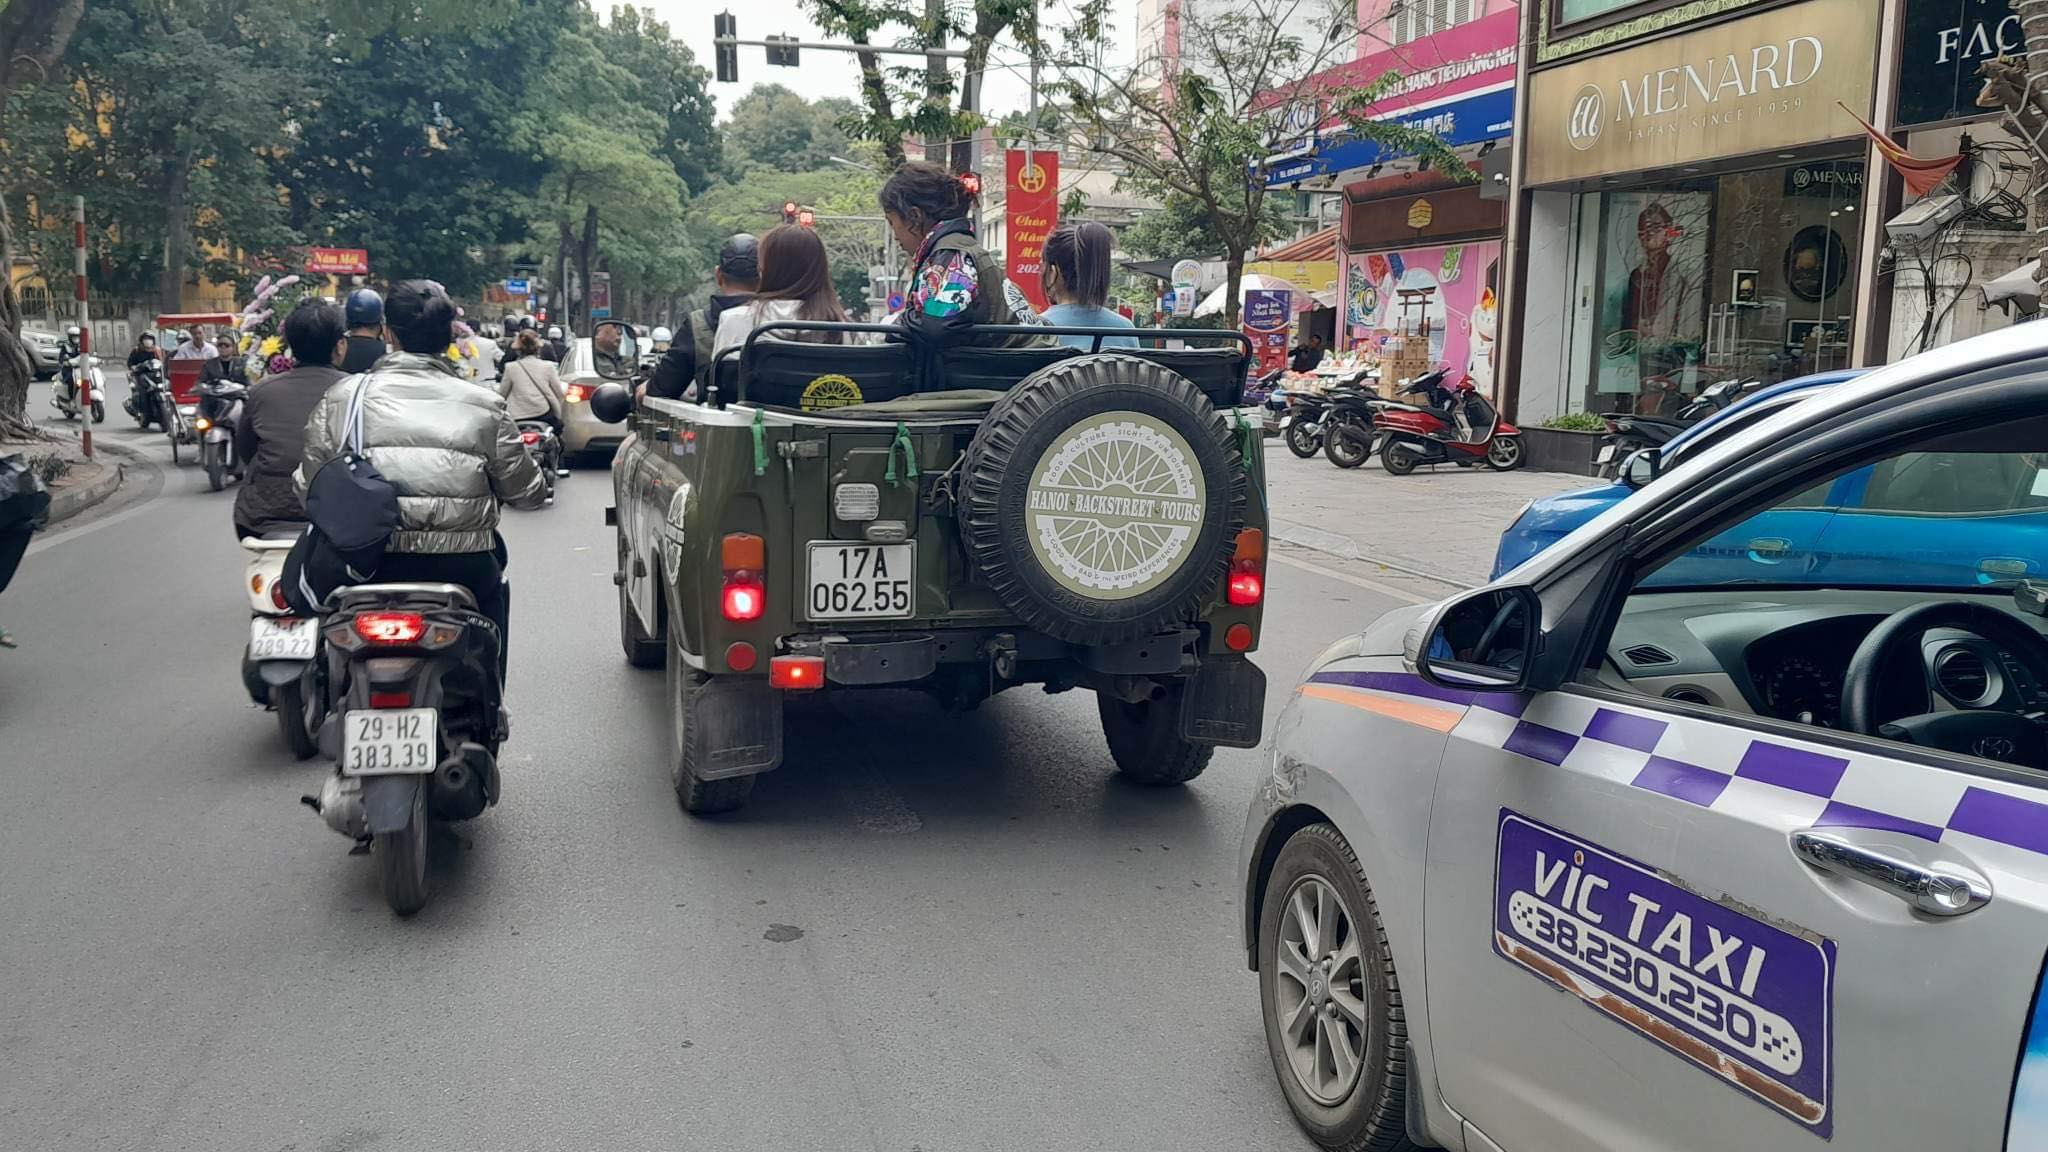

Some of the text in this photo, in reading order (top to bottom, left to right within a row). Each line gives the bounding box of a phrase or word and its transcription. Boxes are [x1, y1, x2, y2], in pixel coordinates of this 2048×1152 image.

[1935, 14, 2021, 64] FAC
[1615, 36, 1824, 122] MENARD
[1628, 97, 1802, 142] JAPAN SINCE 1959
[1811, 169, 1865, 185] MENAR
[1049, 460, 1064, 483] FOOD
[1070, 430, 1107, 453] CULTURE
[1154, 440, 1169, 454] FUN
[1030, 490, 1201, 522] HANOI BACKSTREET TOURS
[838, 547, 888, 579] 17A
[1078, 568, 1093, 578] BAD
[1113, 571, 1138, 581] WEIRD
[1139, 537, 1180, 574] EXPERIENCES
[813, 580, 909, 612] 062.55
[253, 638, 312, 657] 289.22
[359, 715, 421, 741] 29-H2
[350, 743, 429, 769] 383.39
[1627, 892, 1767, 999] TAXI
[1535, 906, 1757, 1048] 38.230.230
